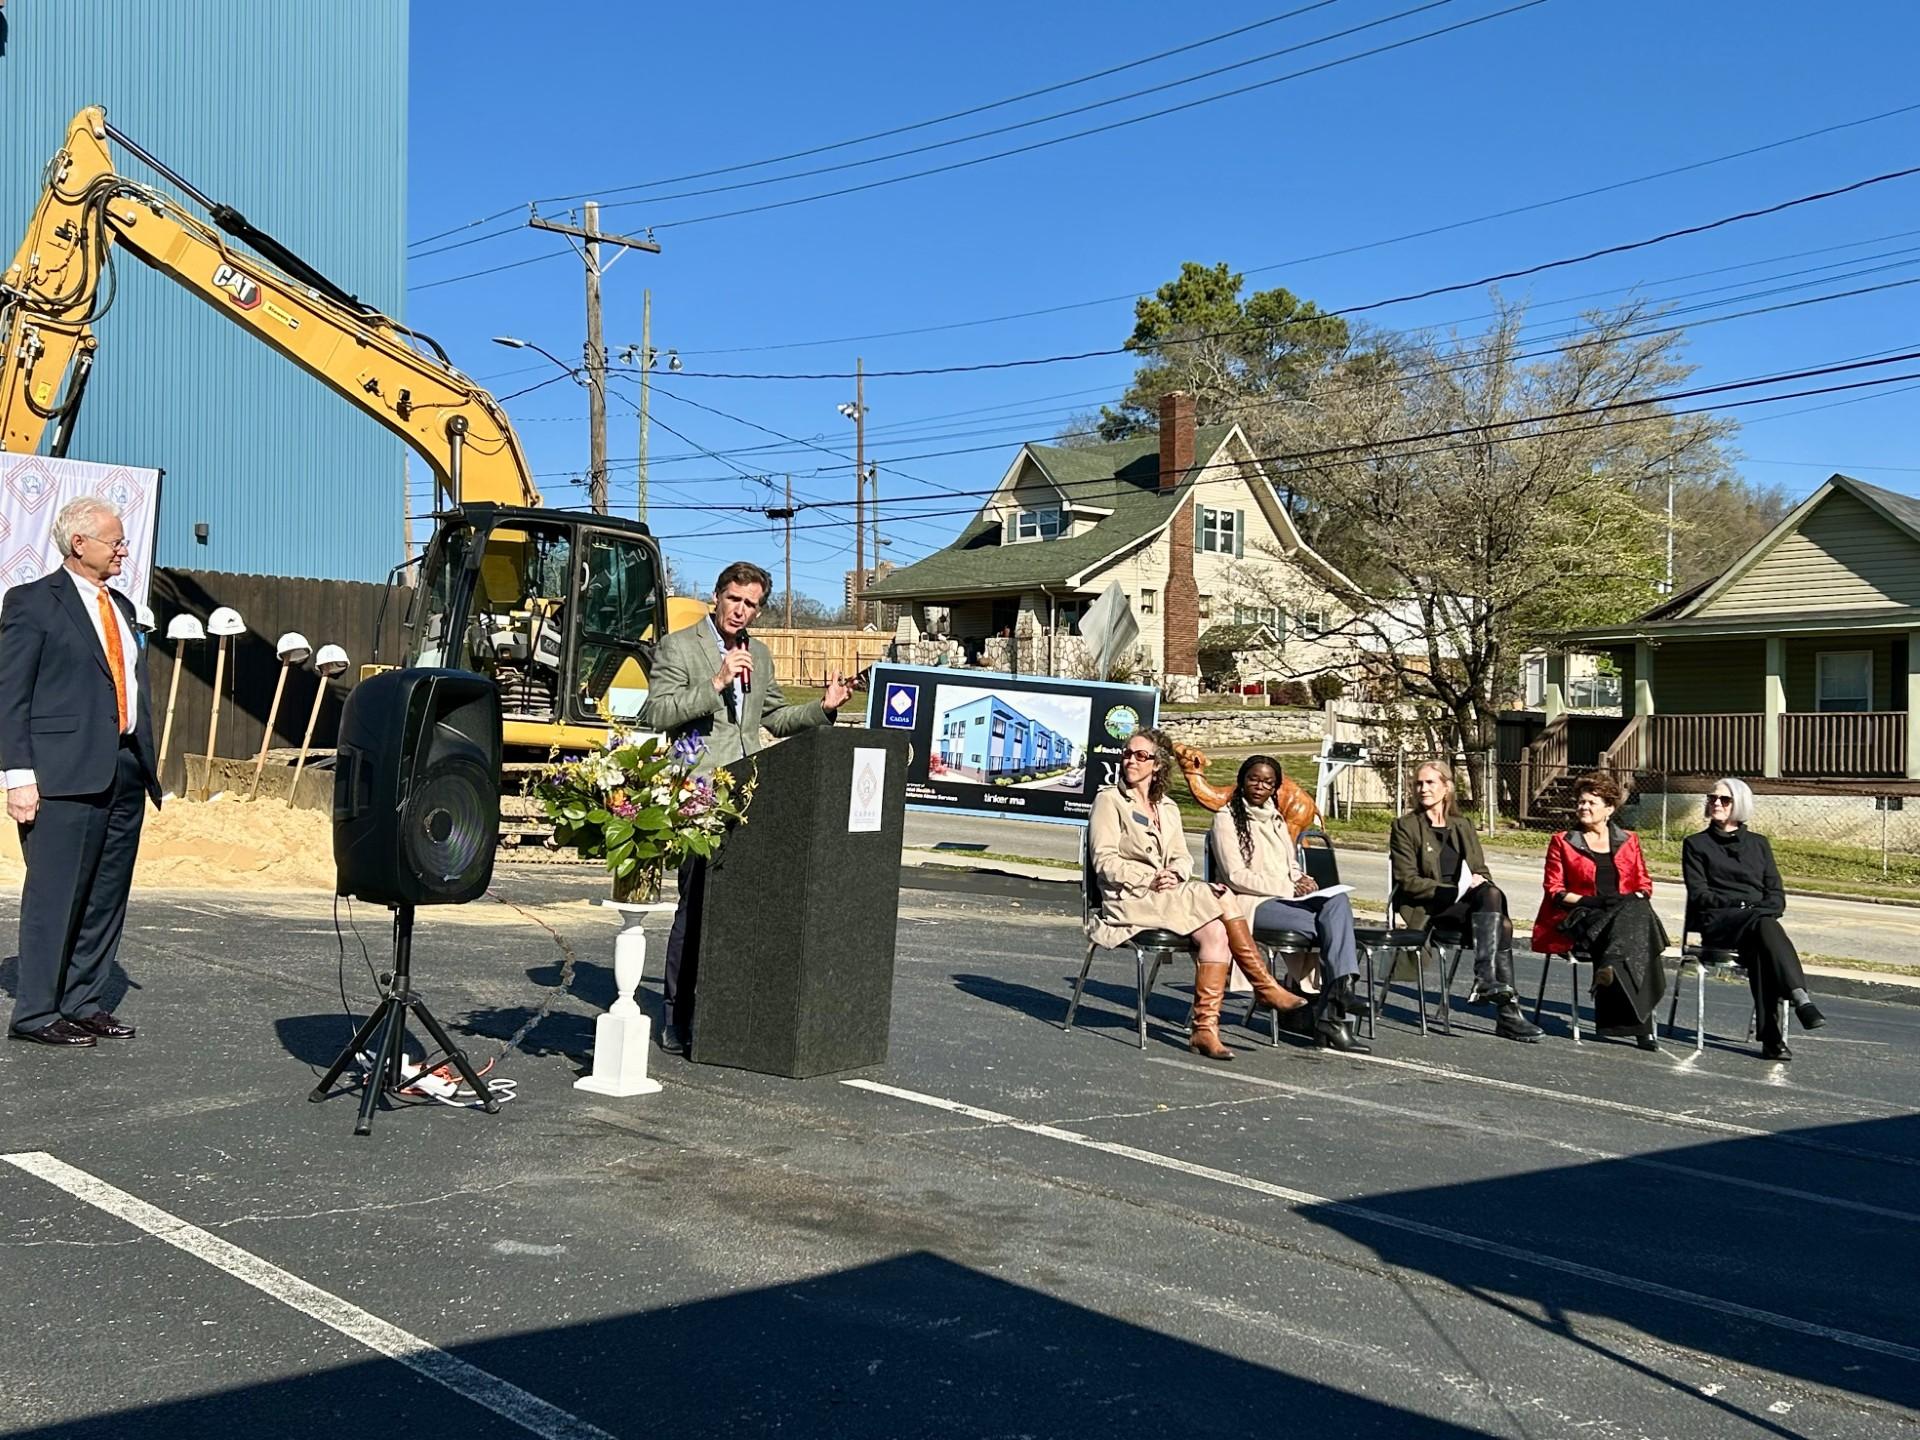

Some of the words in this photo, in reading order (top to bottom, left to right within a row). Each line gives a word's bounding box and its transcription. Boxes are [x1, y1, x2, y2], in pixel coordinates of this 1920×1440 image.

[213, 264, 257, 301] CAT
[983, 793, 1009, 804] tinker
[1009, 797, 1026, 806] ma
